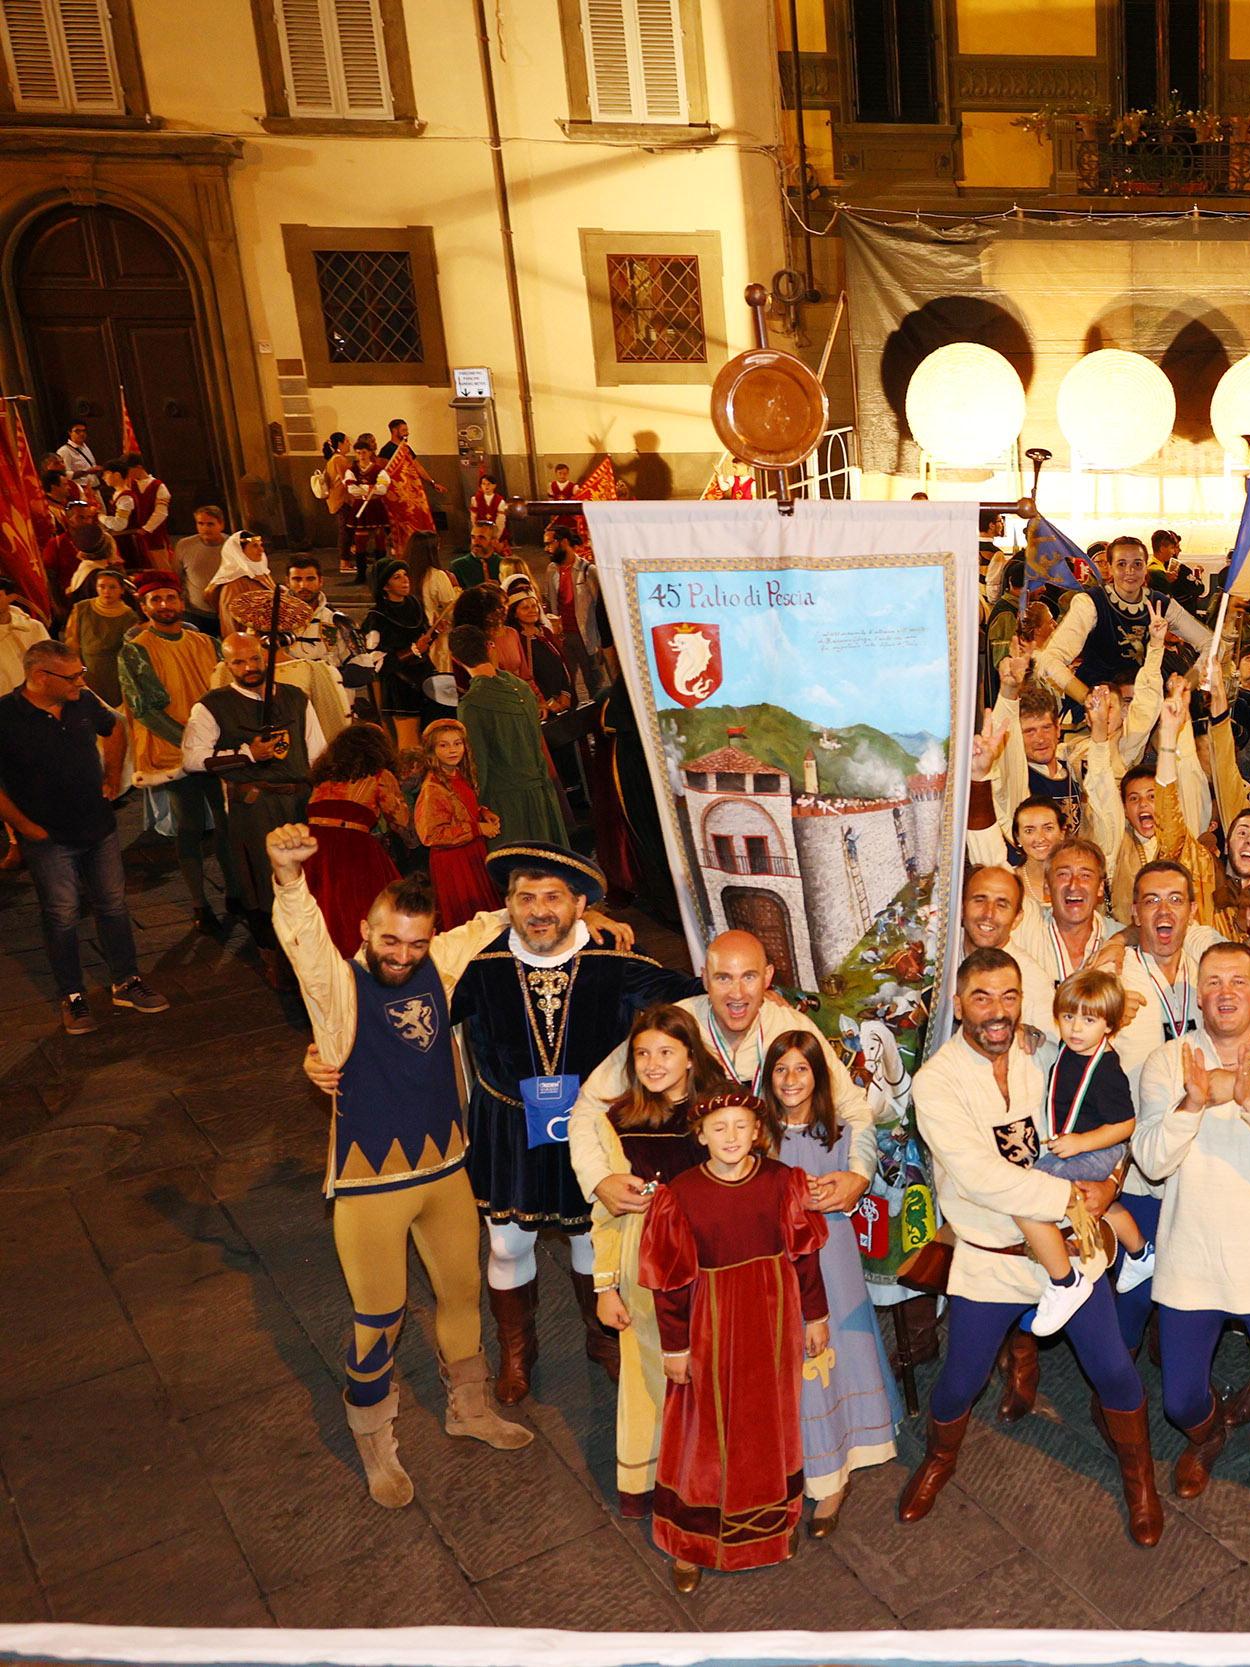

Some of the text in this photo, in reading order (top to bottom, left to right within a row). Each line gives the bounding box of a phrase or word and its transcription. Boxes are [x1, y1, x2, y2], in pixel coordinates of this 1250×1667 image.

[688, 582, 740, 608] Palio
[744, 584, 762, 607] di
[766, 579, 816, 608] Pescia
